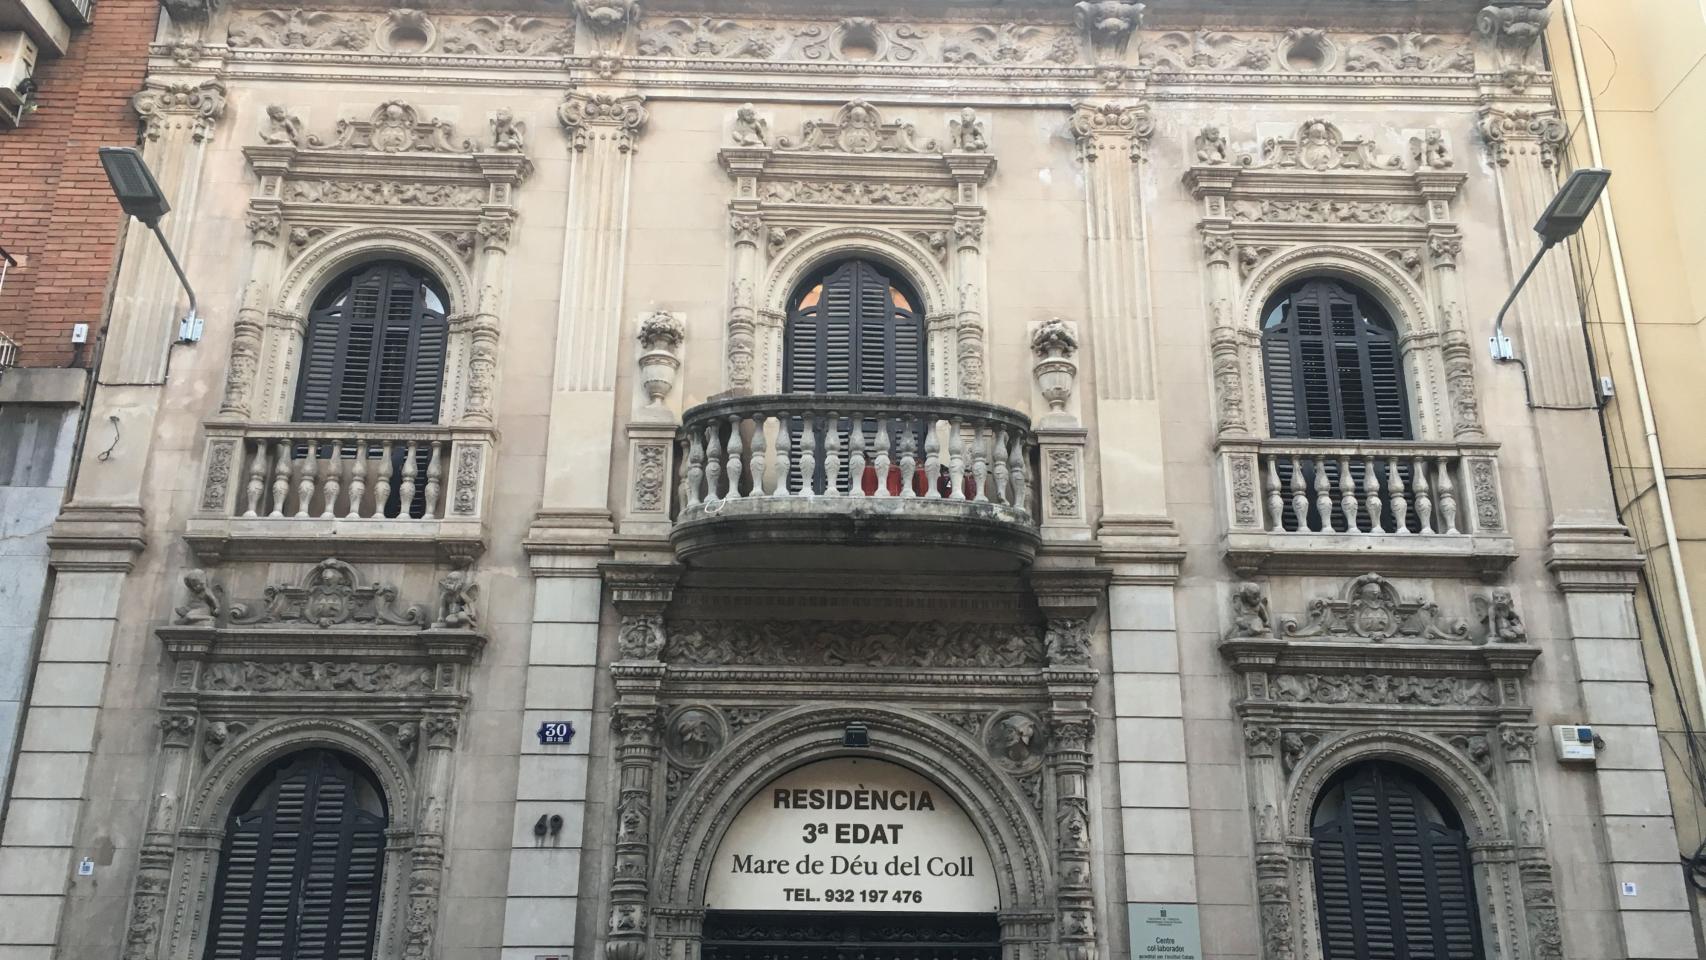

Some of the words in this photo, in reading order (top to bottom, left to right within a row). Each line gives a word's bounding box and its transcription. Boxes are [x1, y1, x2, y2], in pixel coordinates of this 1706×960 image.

[545, 723, 567, 737] 30
[773, 784, 935, 812] RESIDÈNCIA
[802, 823, 829, 845] 3ª
[835, 823, 904, 845] EDAT
[731, 854, 790, 875] Mare
[795, 855, 824, 876] de
[830, 855, 878, 876] Déu
[884, 856, 921, 877] del
[926, 856, 975, 878] Coll
[783, 888, 821, 903] TEL.
[824, 889, 855, 903] 932
[860, 889, 889, 904] 197
[892, 889, 923, 905] 476
